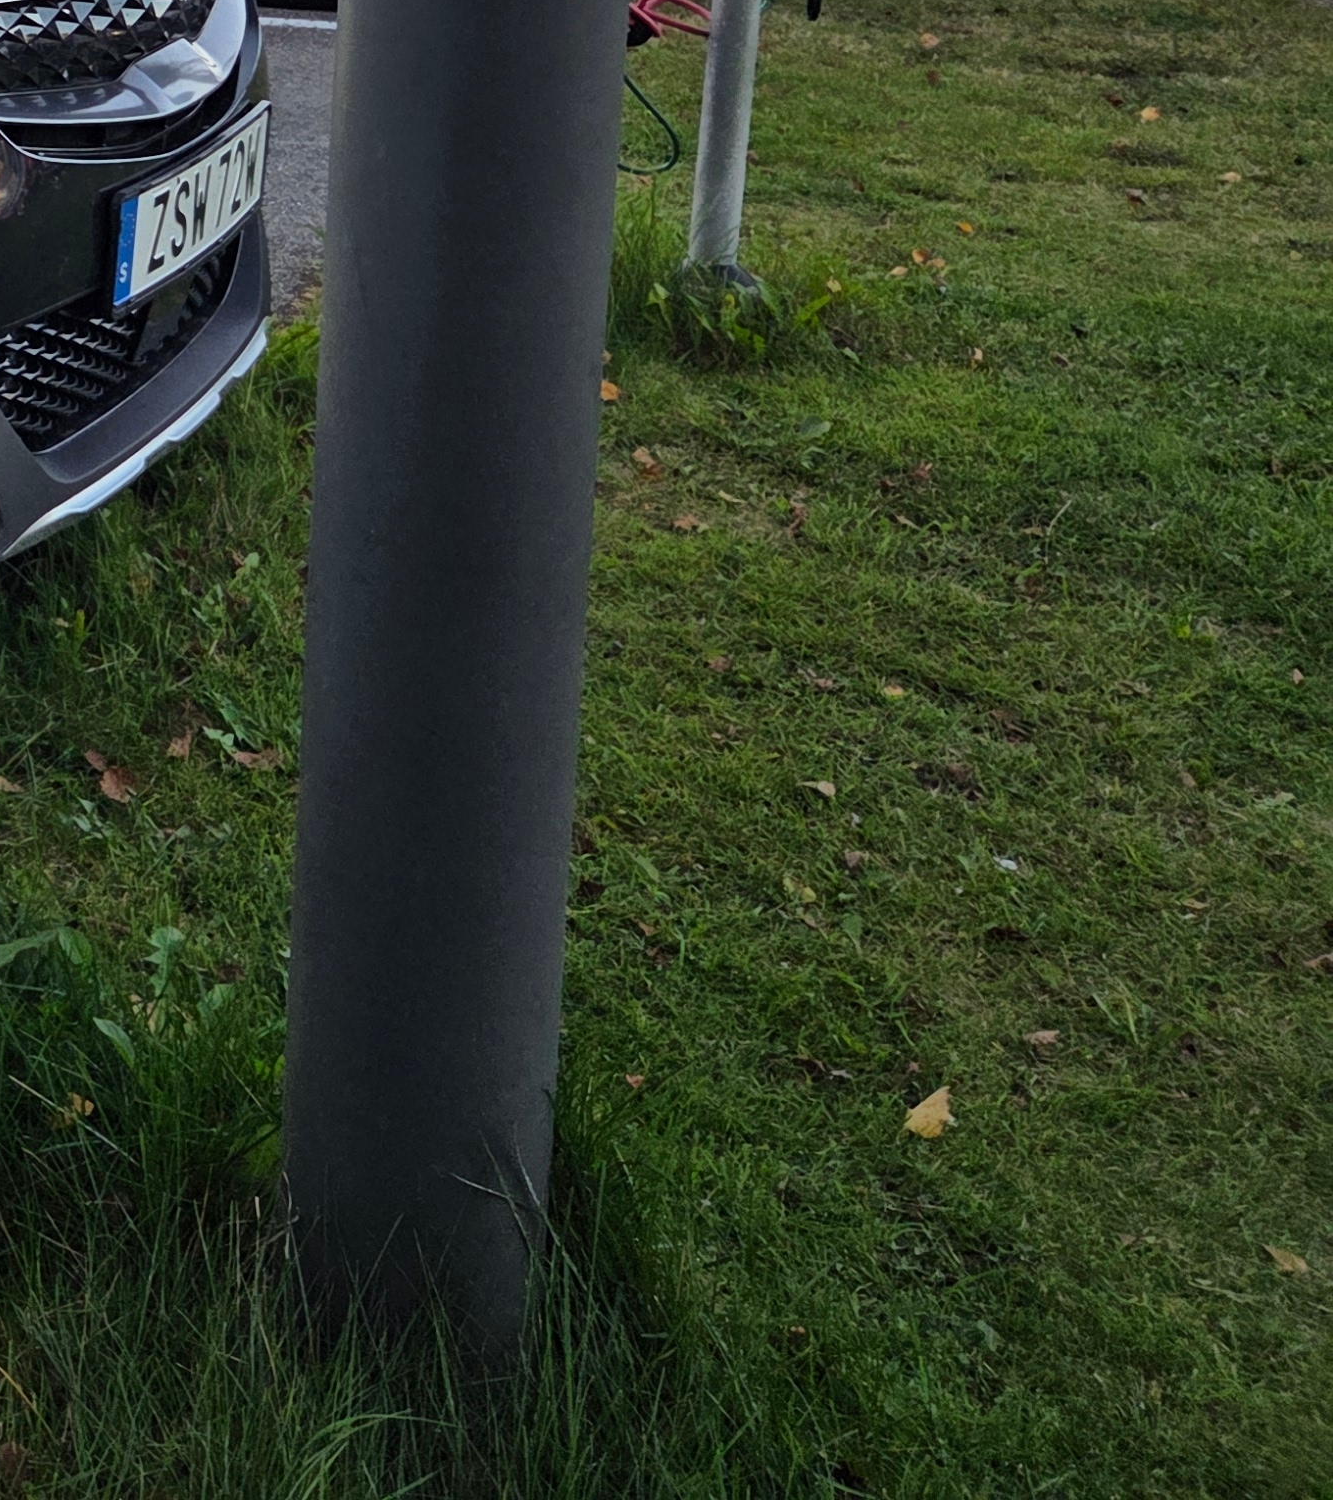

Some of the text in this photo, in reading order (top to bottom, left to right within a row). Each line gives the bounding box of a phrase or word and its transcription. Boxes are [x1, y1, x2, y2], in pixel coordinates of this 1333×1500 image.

[147, 122, 262, 275] ZSW 72W
[118, 262, 128, 284] S
